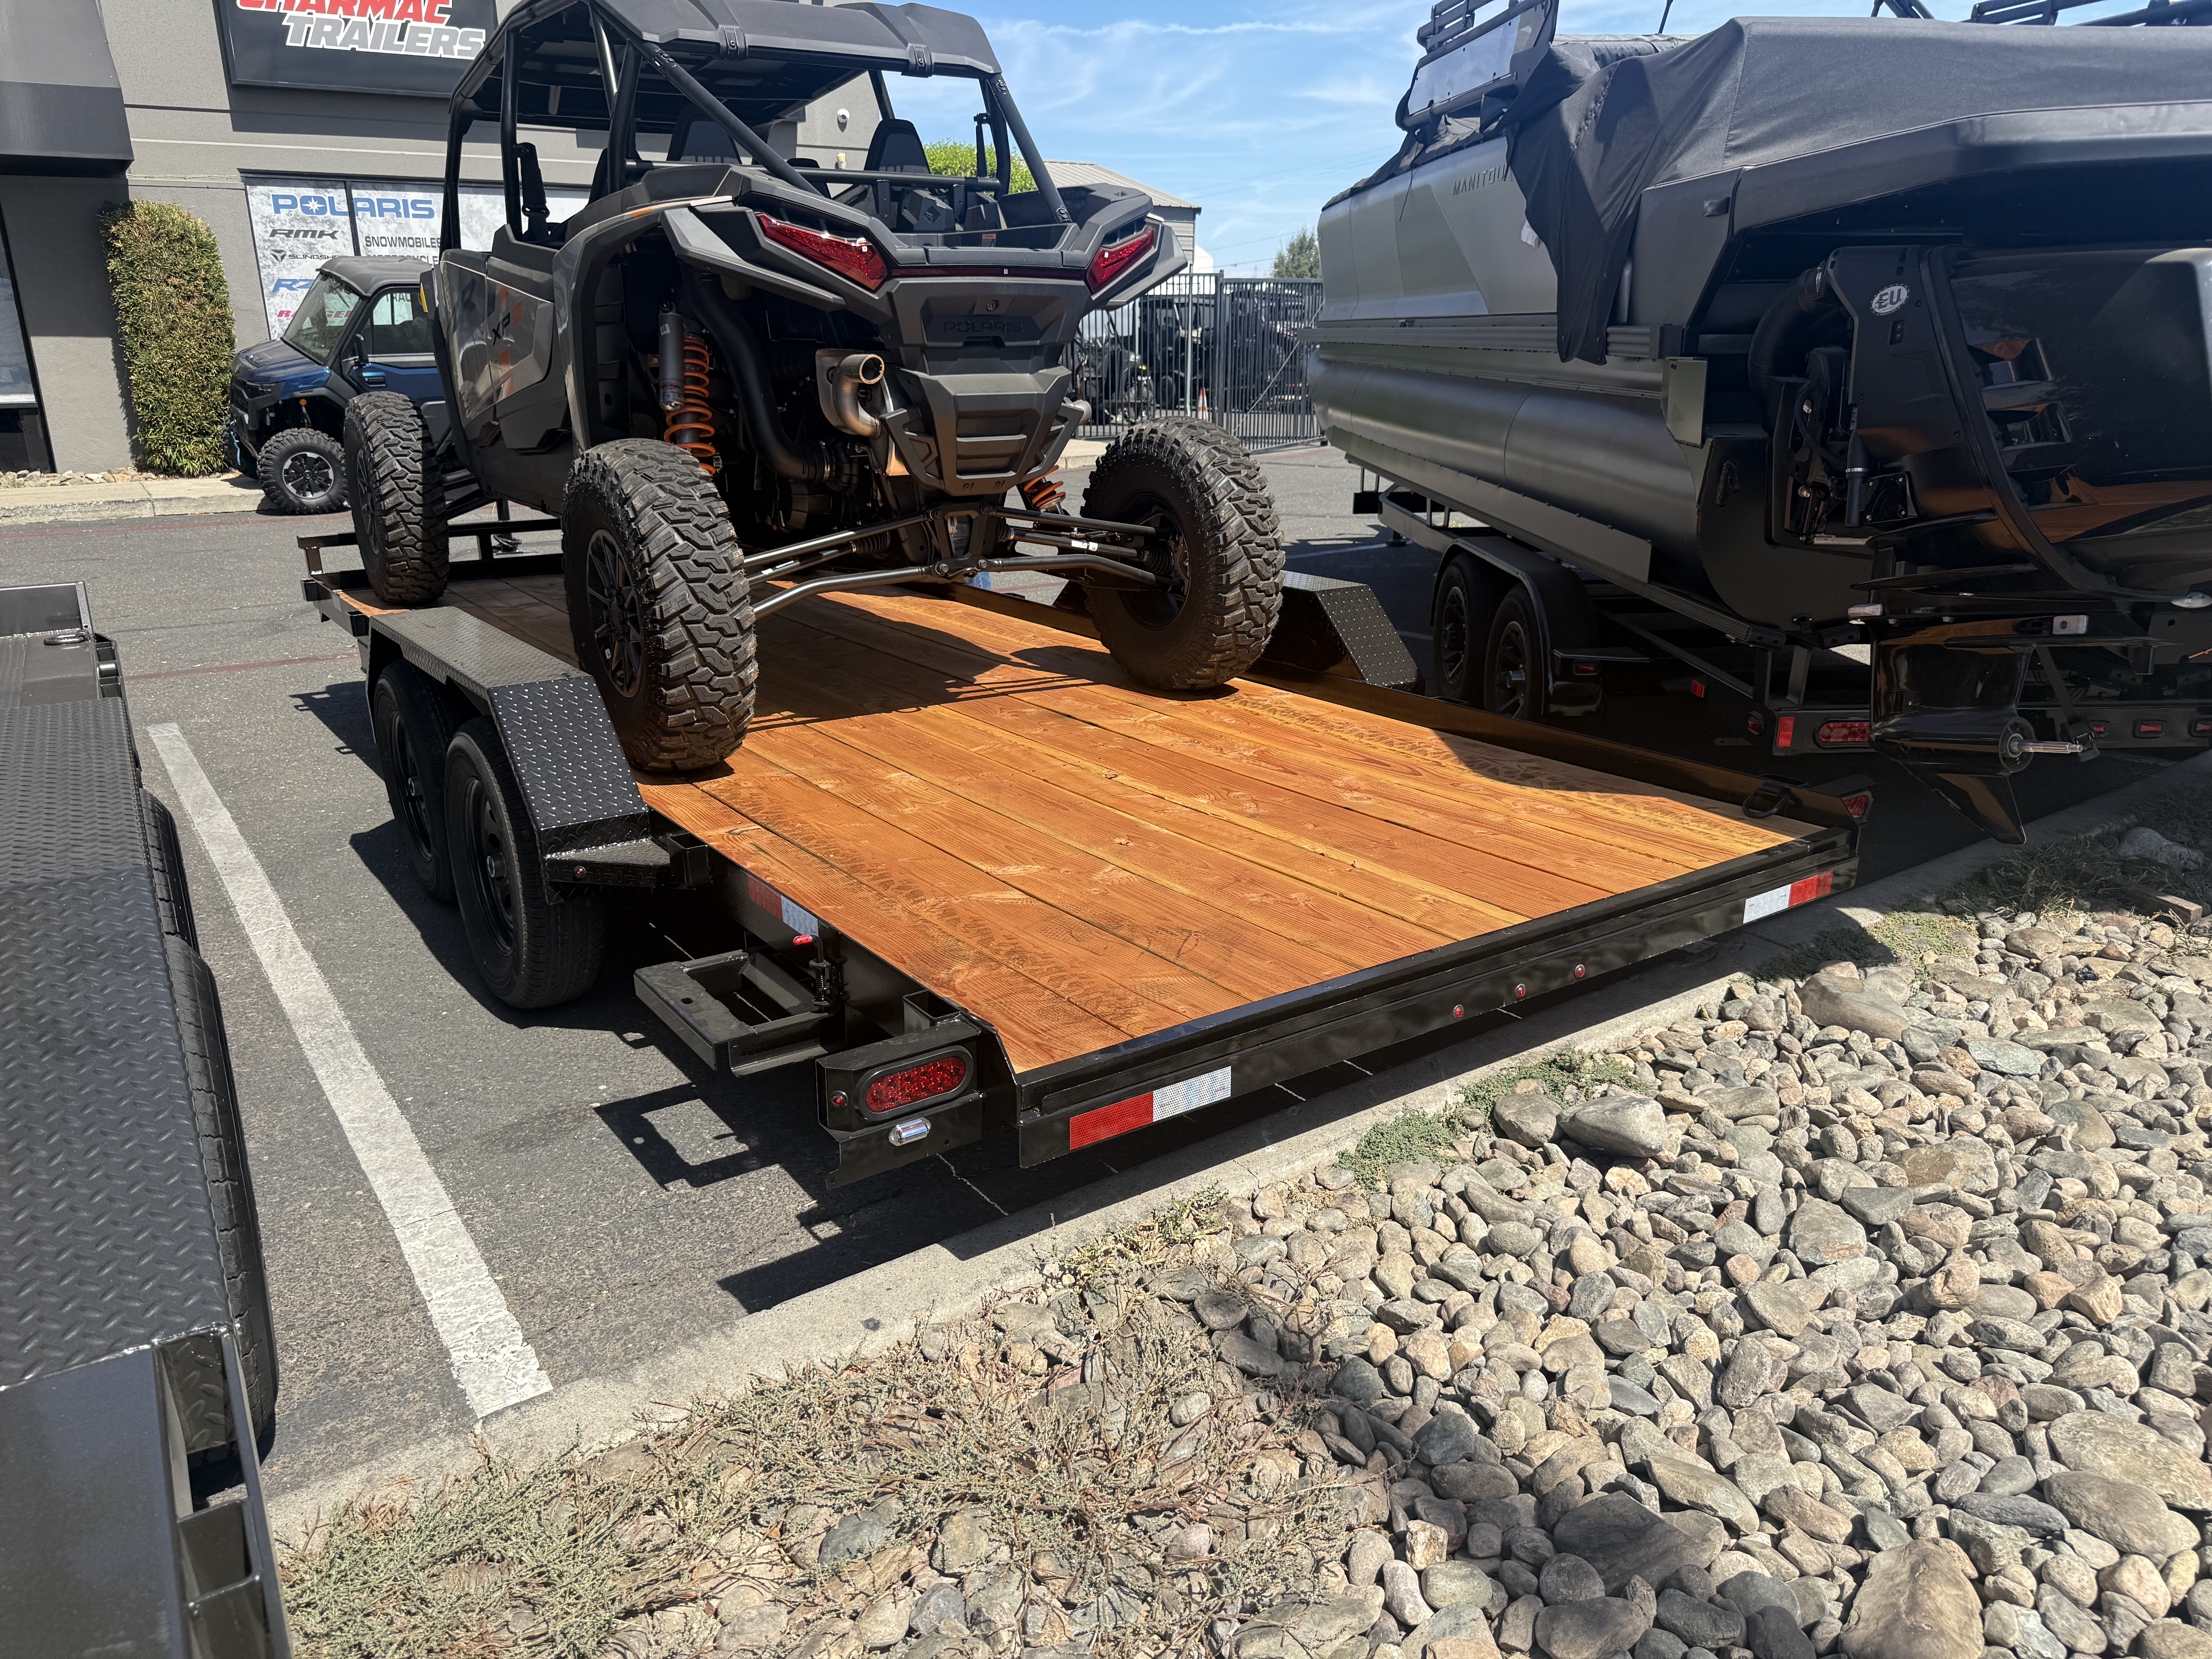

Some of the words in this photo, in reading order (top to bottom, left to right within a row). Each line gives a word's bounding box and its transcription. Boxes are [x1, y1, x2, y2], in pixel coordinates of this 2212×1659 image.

[239, 0, 450, 24] RMAC
[286, 15, 484, 57] TRAILERS
[1453, 164, 1505, 196] MANITOU
[271, 194, 434, 219] POLARIS
[269, 229, 339, 240] RMK
[1878, 288, 1901, 309] EU
[944, 321, 1023, 332] POLARIS
